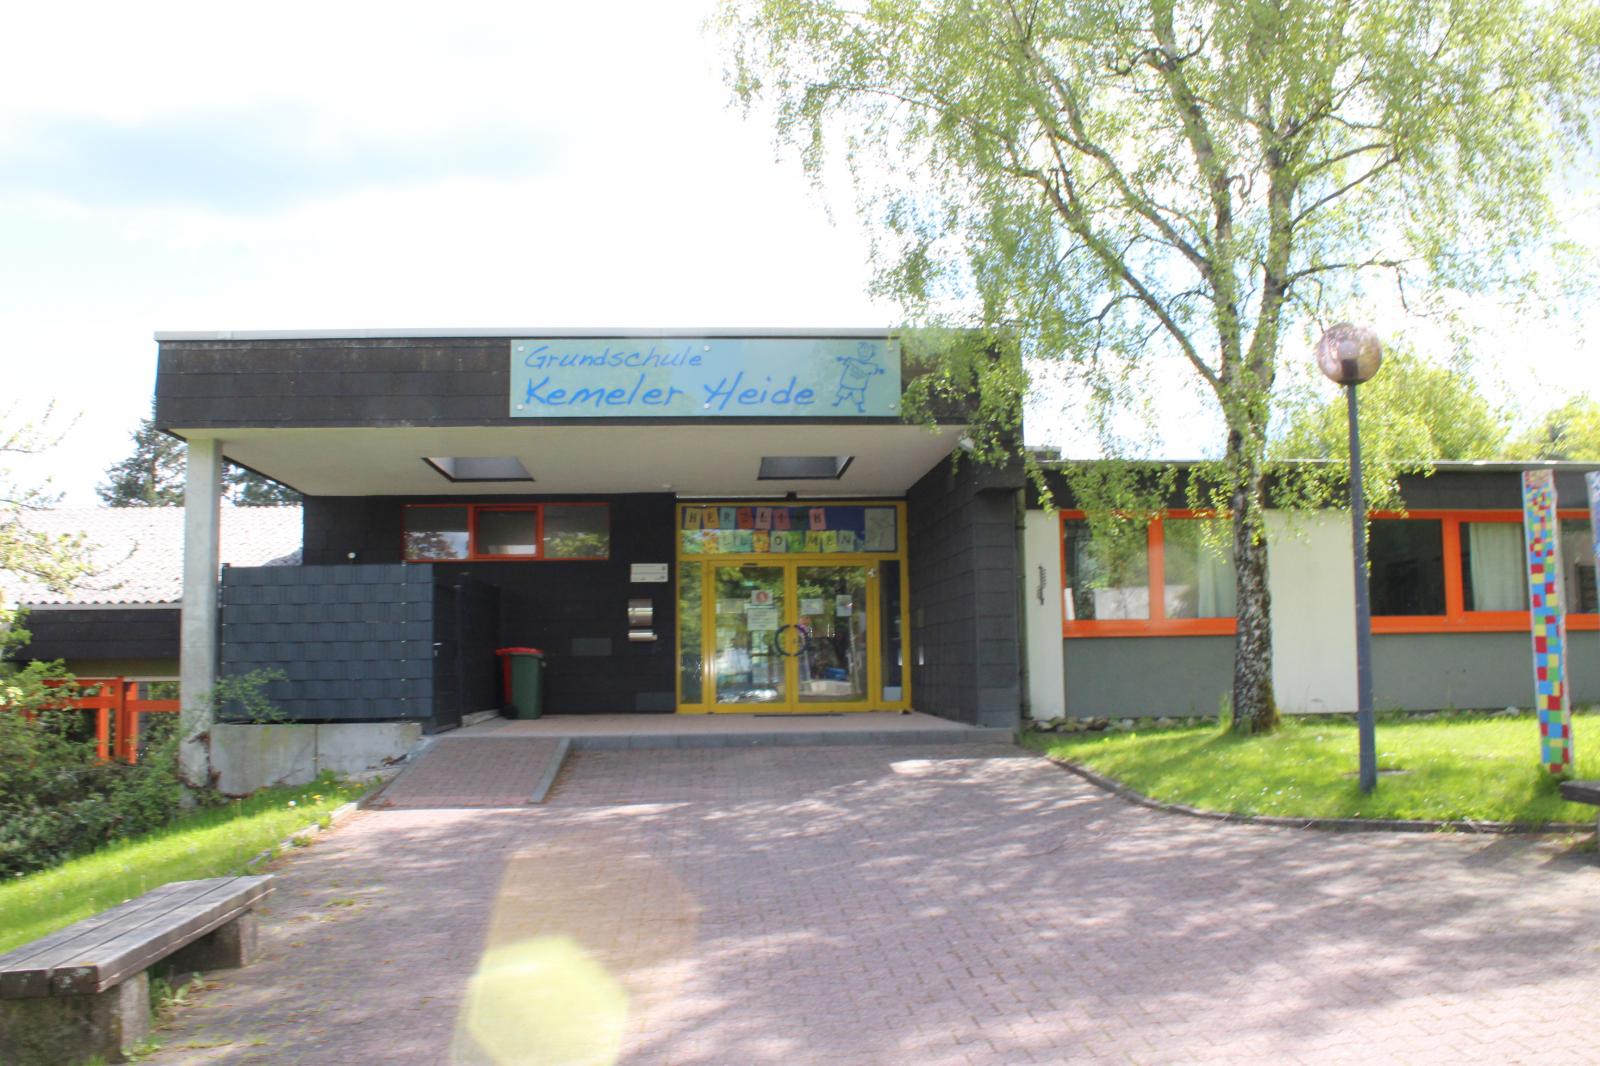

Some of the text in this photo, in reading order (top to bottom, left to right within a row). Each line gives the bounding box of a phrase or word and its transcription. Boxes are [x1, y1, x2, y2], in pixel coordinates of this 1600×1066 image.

[525, 346, 703, 369] Grundschule
[524, 370, 816, 412] Kemeler Heide
